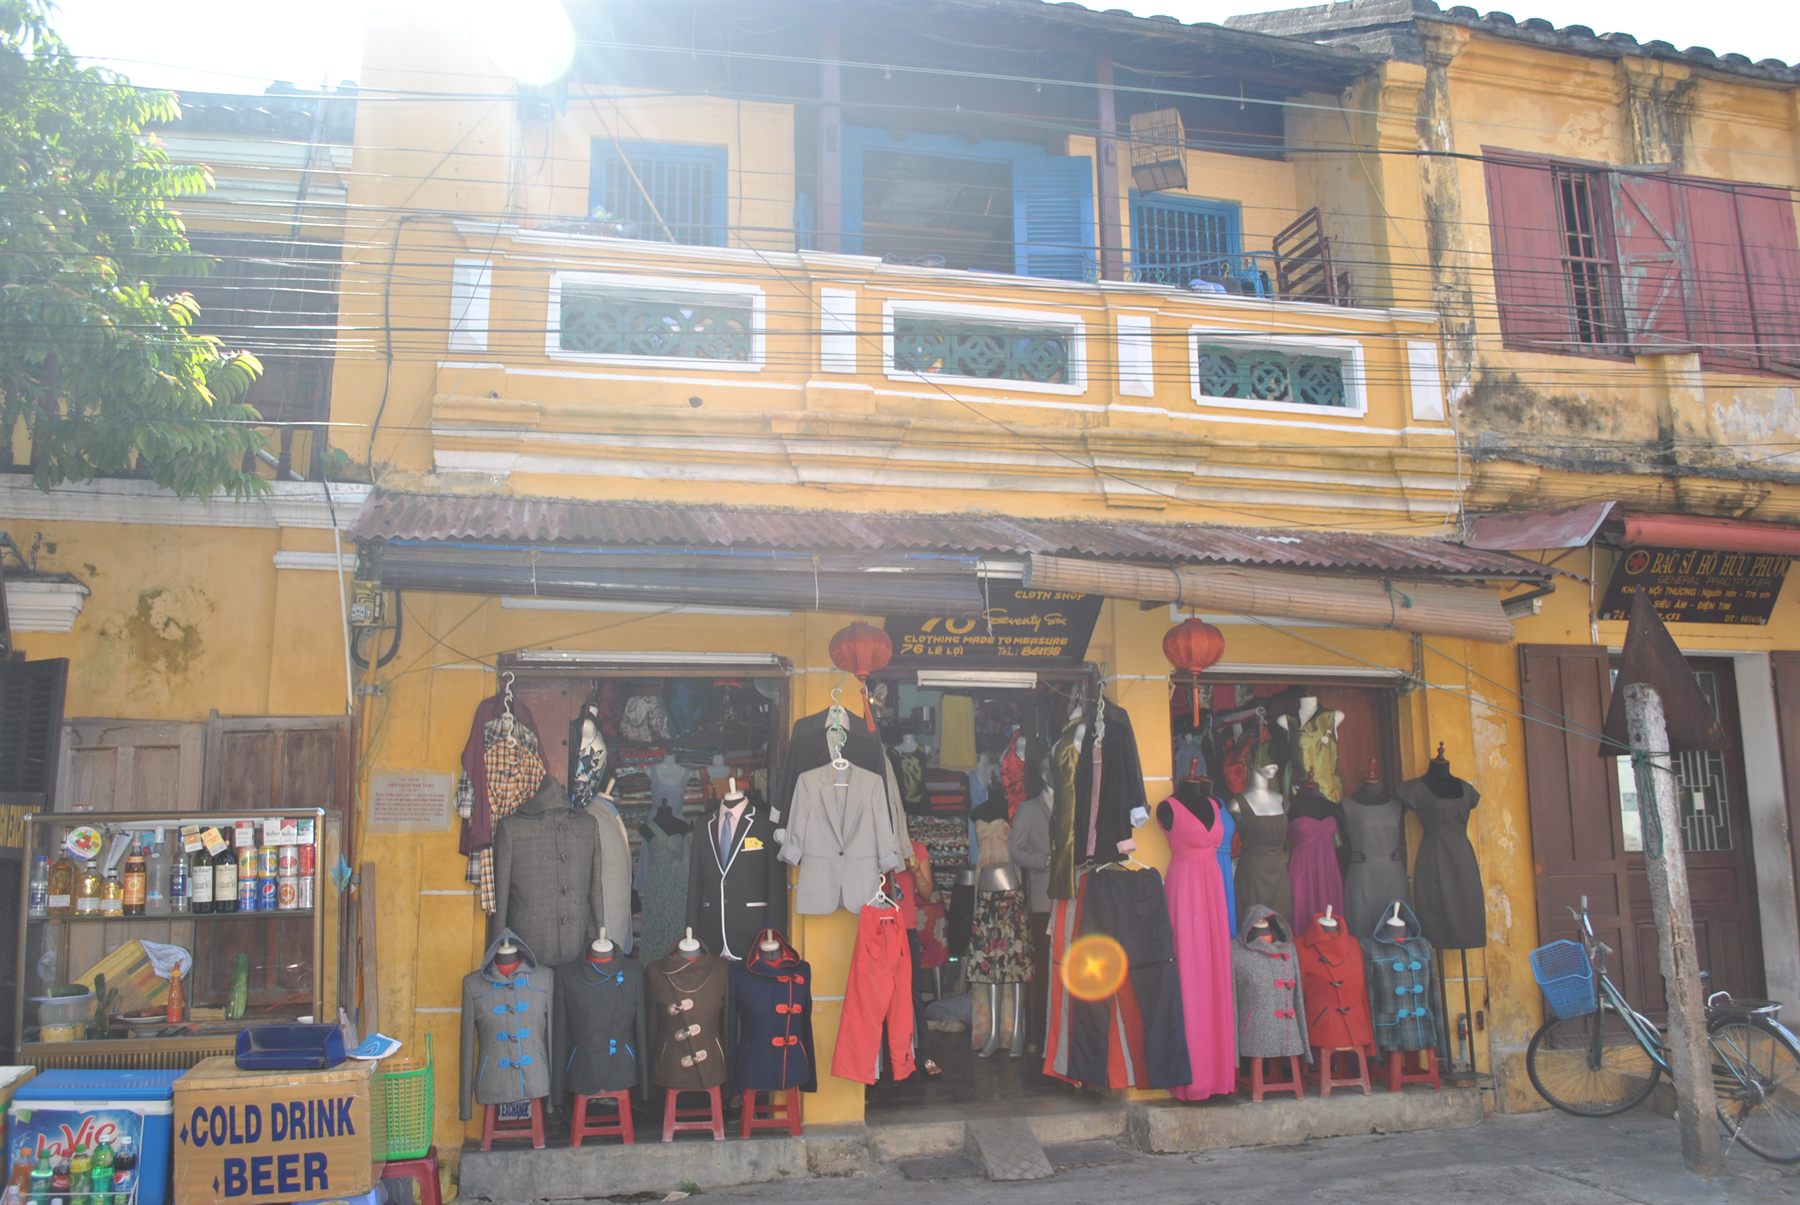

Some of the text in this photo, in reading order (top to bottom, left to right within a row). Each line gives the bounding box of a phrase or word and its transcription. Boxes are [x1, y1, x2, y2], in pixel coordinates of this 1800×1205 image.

[1014, 591, 1052, 600] CLOTH
[903, 635, 1069, 646] CLOTHING MADE TO MEASURE
[900, 643, 925, 655] 76
[191, 1096, 356, 1148] COLD DRINK
[223, 1151, 329, 1198] BEER
